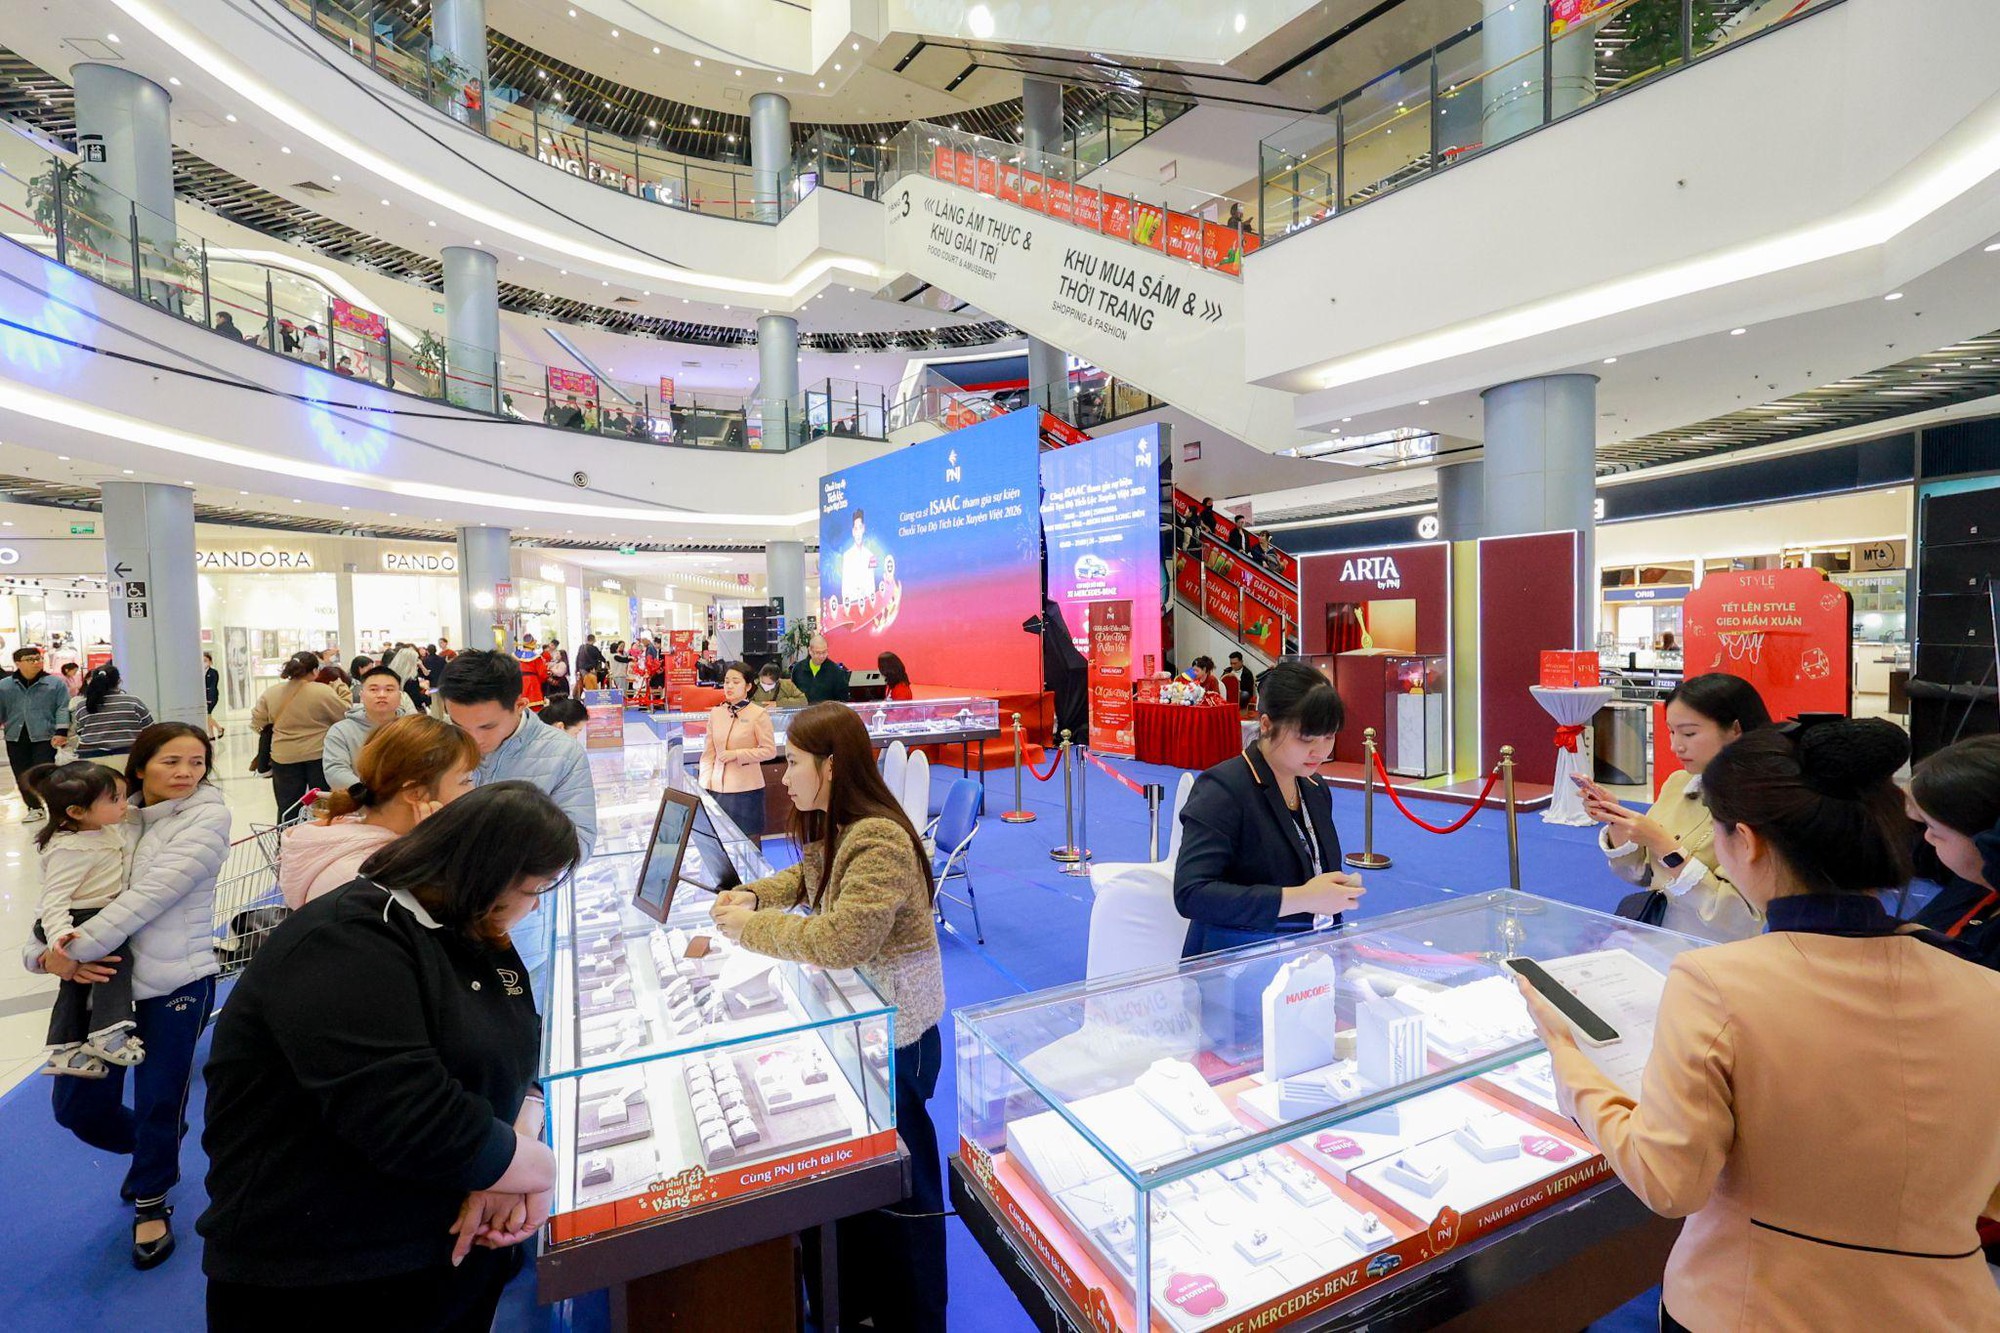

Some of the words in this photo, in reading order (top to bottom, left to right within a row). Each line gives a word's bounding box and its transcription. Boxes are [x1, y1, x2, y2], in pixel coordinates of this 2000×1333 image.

[901, 189, 911, 217] 3
[935, 198, 965, 225] LÀNG
[987, 217, 1021, 246] THỰC
[1023, 231, 1032, 251] &
[1109, 219, 1122, 232] TEA
[930, 222, 953, 246] KHU
[979, 241, 1000, 264] TRÍ
[927, 244, 942, 257] FOOD
[942, 249, 959, 264] COURT
[963, 260, 997, 281] AMUSEMENT
[1063, 248, 1098, 277] KHU
[1098, 260, 1136, 292] MUA
[1138, 274, 1182, 309] SẮM
[1182, 292, 1197, 316] &
[1059, 275, 1095, 307] THỜI
[1097, 289, 1155, 331] TRANG
[1051, 300, 1087, 323] SHOPPING
[1087, 315, 1093, 326] &
[1094, 318, 1128, 341] FASHION
[946, 466, 961, 483] PNJ
[929, 495, 960, 516] ISAAC
[962, 497, 980, 509] tham
[981, 494, 992, 507] gia
[1003, 487, 1020, 502] kiện
[1064, 485, 1088, 498] ISAAC
[939, 518, 952, 530] Tích
[965, 513, 988, 526] Xuyên
[989, 508, 1003, 521] Việt
[1003, 504, 1022, 518] 2026
[387, 553, 455, 571] PANDO
[1339, 556, 1400, 581] ARTA
[1377, 580, 1386, 590] by
[1386, 578, 1400, 589] PNJ
[1739, 575, 1775, 587] STYLE
[1857, 577, 1893, 586] CENTER
[1634, 590, 1655, 599] ORIS
[1218, 603, 1240, 624] NHIÊ
[1722, 601, 1739, 612] TẾT
[1741, 601, 1761, 612] LÊN
[1764, 602, 1796, 612] STYLE
[1716, 616, 1740, 626] GIEO
[1771, 614, 1802, 626] XUÂN
[1286, 983, 1331, 1005] MANCODE
[650, 1180, 665, 1192] Vui
[682, 1165, 704, 1185] Tết
[740, 1169, 772, 1187] Cùng
[774, 1163, 796, 1177] PNJ
[797, 1155, 818, 1170] tích
[820, 1153, 834, 1165] tài
[836, 1149, 853, 1162] lộc
[684, 1181, 702, 1194] như
[1478, 1218, 1483, 1228] 1
[1483, 1208, 1504, 1225] NĂM
[1504, 1203, 1521, 1218] BAY
[1520, 1191, 1544, 1211] CÙNG
[1546, 1167, 1595, 1196] VIETNAM
[652, 1192, 690, 1212] Vàng
[1008, 1203, 1026, 1231] Cùng
[1024, 1222, 1038, 1246] PNJ
[1037, 1239, 1051, 1262] tích
[1051, 1254, 1061, 1274] tài
[1060, 1264, 1073, 1288] lộc
[1437, 1226, 1452, 1242] PNJ
[1249, 1269, 1359, 1333] MERCEDES-BENZ
